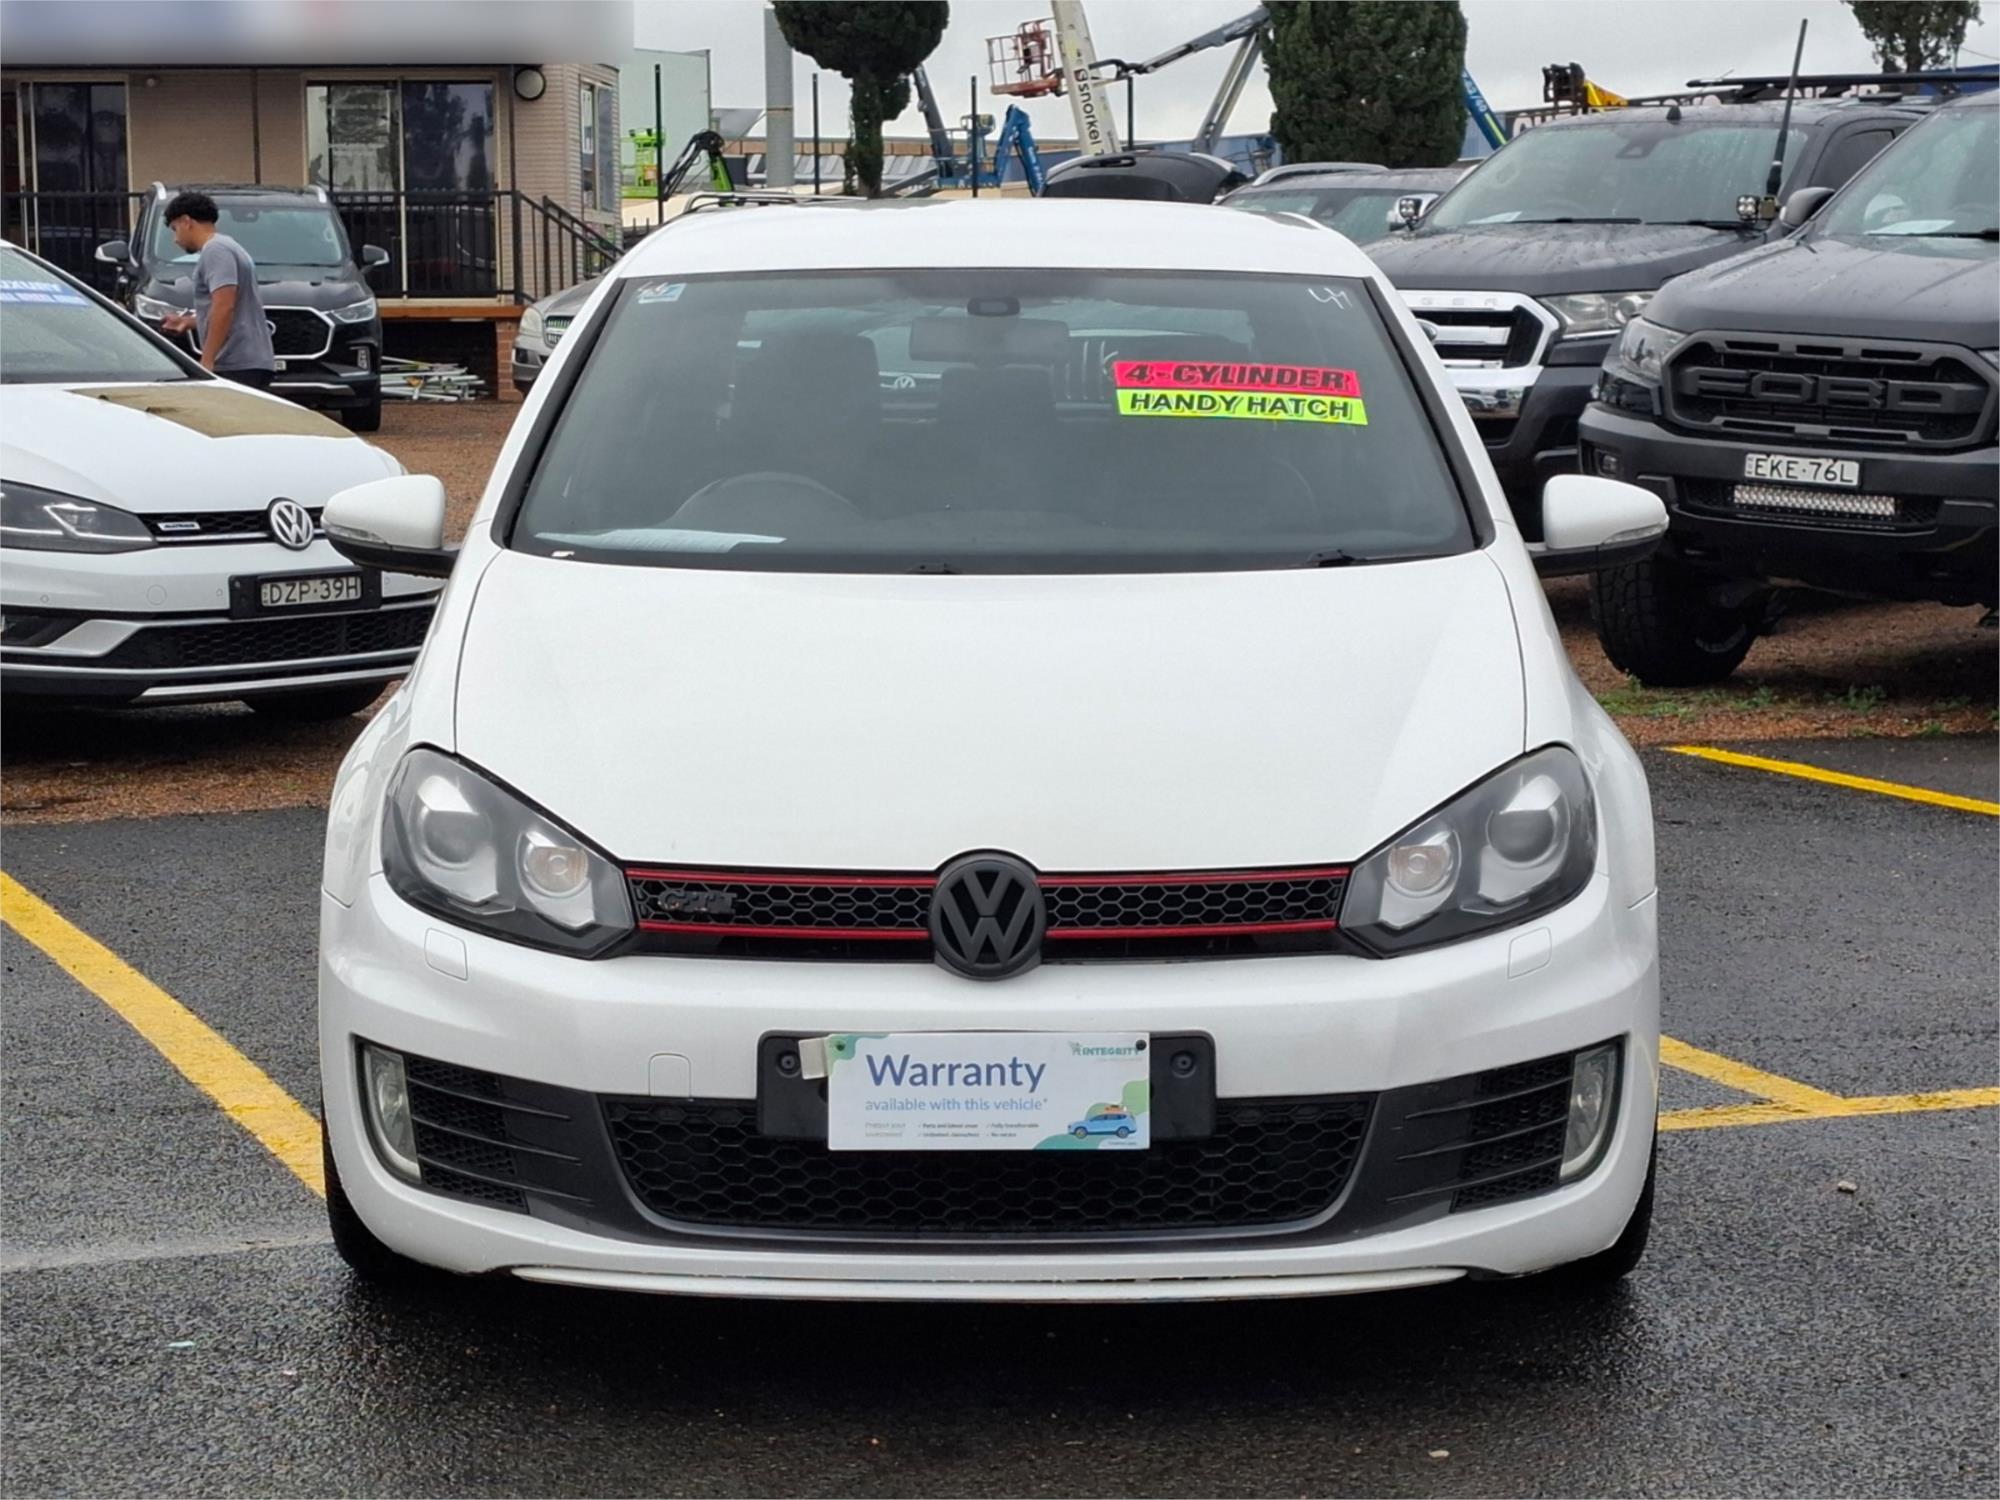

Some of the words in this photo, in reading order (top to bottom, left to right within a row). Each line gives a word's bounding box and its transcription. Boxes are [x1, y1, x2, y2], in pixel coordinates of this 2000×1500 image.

[1078, 84, 1102, 145] snorkel
[1125, 364, 1350, 390] 4-CYLINDER
[1680, 366, 1988, 413] FORD
[1130, 393, 1242, 413] HANDY
[1246, 396, 1350, 419] HATCH
[866, 1053, 1046, 1093] Warranty
[865, 1098, 926, 1111] available
[929, 1098, 961, 1111] with
[965, 1098, 990, 1111] this
